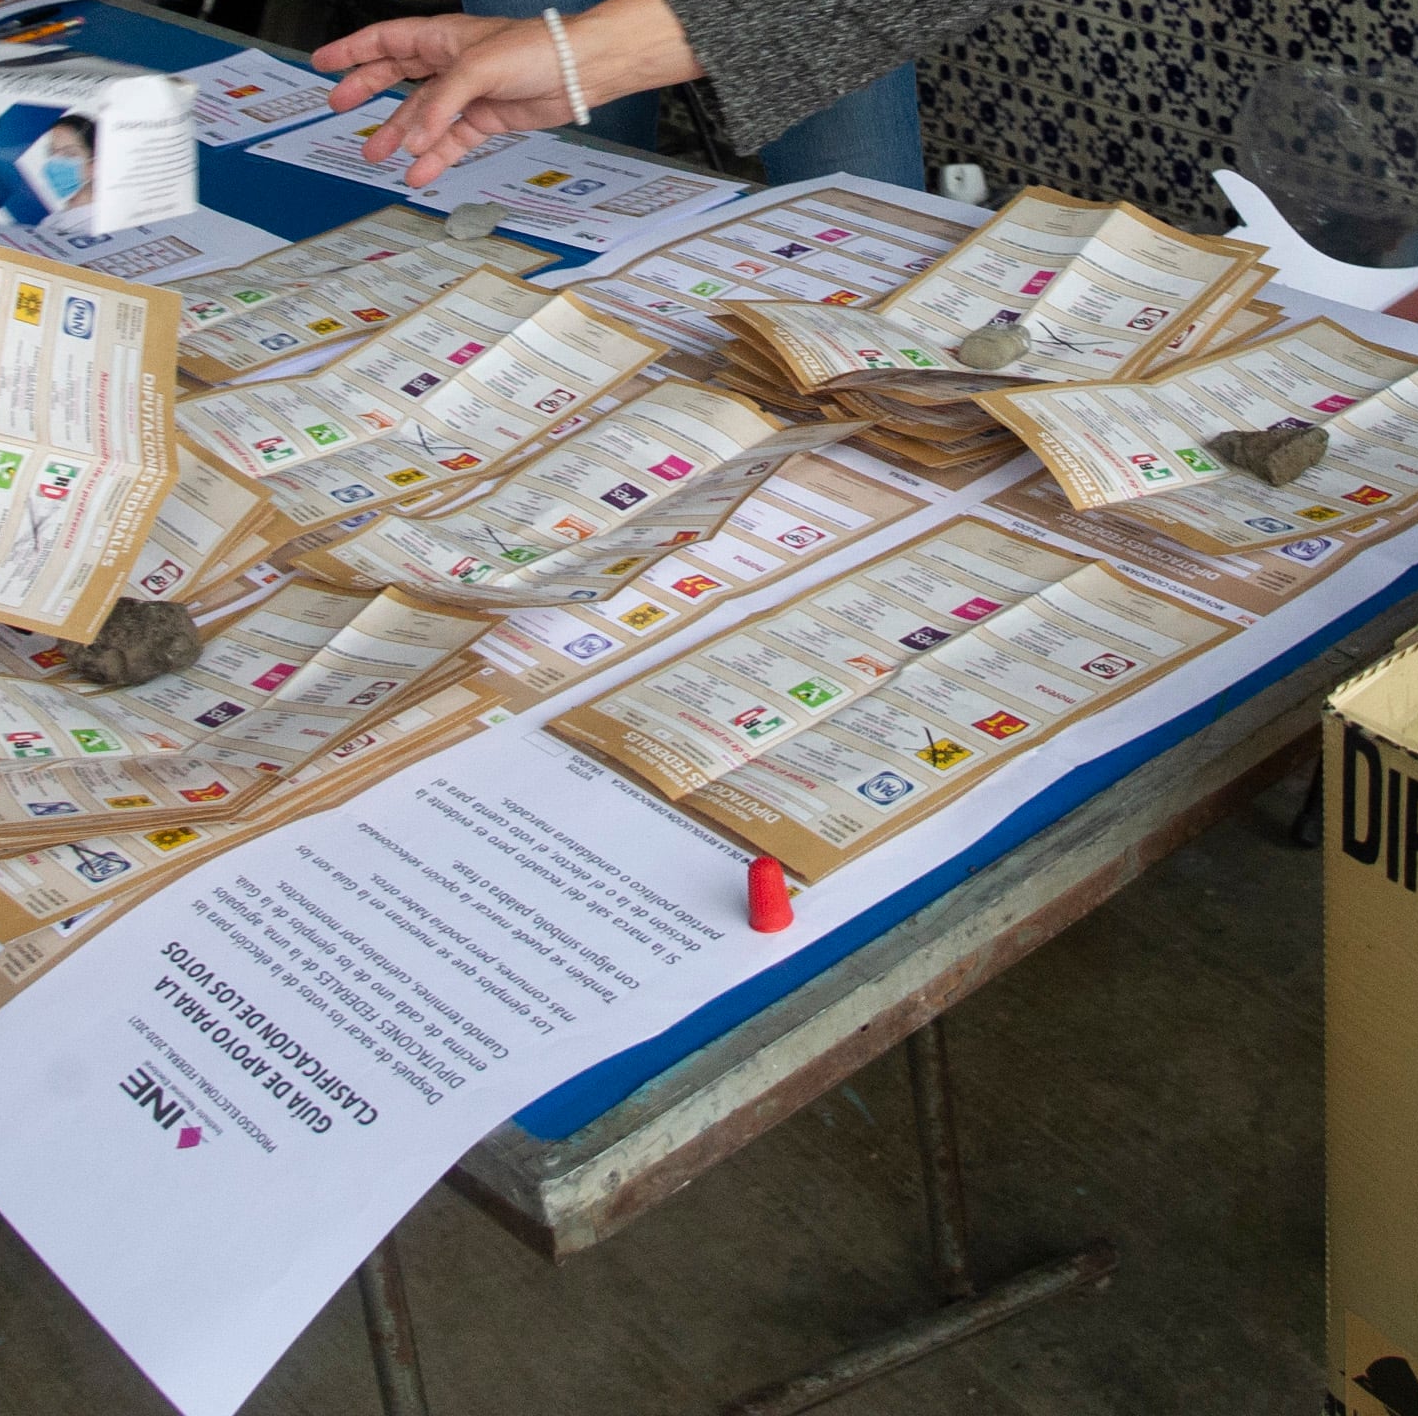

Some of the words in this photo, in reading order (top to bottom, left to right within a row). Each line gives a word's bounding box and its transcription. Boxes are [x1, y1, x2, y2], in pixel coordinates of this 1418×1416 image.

[140, 372, 157, 483] DIPUTACIONES
[101, 483, 149, 568] FEDERALES
[620, 730, 690, 772] FEDERALES
[414, 787, 429, 800] la
[429, 777, 448, 787] el
[445, 785, 476, 803] para
[871, 778, 899, 797] PAN
[686, 769, 780, 823] DIPUTACIOES
[426, 796, 474, 827] evidente
[470, 801, 510, 827] cuenta
[500, 796, 556, 834] marcados.
[471, 825, 489, 837] es
[507, 825, 535, 845] voto
[294, 844, 315, 859] los
[486, 835, 519, 855] pero
[530, 842, 549, 853] el
[552, 831, 621, 876] candidatura
[310, 856, 335, 872] son
[513, 853, 566, 888] recuadro
[549, 850, 592, 880] elector,
[234, 874, 262, 898] Guía.
[330, 870, 359, 891] Guía
[369, 872, 401, 895] otros.
[560, 885, 587, 901] del
[586, 879, 606, 889] el
[190, 898, 210, 916] las
[211, 886, 264, 926] agrúpalos
[259, 895, 274, 908] la
[275, 879, 342, 931] montoncitos.
[356, 888, 371, 901] la
[367, 897, 387, 910] en
[396, 894, 433, 920] haber
[615, 895, 631, 908] la
[628, 880, 680, 911] político
[205, 910, 236, 932] para
[271, 904, 289, 918] de
[585, 899, 613, 918] sale
[629, 904, 649, 917] de
[262, 924, 291, 949] urna,
[286, 916, 337, 955] ejemplos
[337, 928, 365, 945] por
[383, 909, 439, 948] muestran
[428, 916, 472, 944] podría
[610, 916, 652, 944] marca
[647, 916, 702, 951] decisión
[673, 909, 725, 941] partido
[228, 929, 273, 965] elección
[288, 947, 303, 961] la
[435, 947, 454, 959] se
[464, 942, 499, 964] pero
[650, 942, 667, 956] la
[661, 951, 682, 965] Si
[159, 940, 216, 988] VOTOS
[269, 962, 285, 977] la
[300, 957, 319, 971] de
[334, 954, 355, 972] los
[352, 968, 372, 982] de
[356, 942, 412, 984] cuéntalos
[450, 958, 477, 976] que
[152, 974, 182, 1000] LA
[280, 972, 300, 987] de
[369, 981, 396, 1001] uno
[494, 961, 550, 1003] comunes,
[206, 980, 246, 1012] LOS
[295, 984, 329, 1012] votos
[312, 970, 381, 1022] FEDERALES
[410, 980, 465, 1025] termines,
[474, 975, 531, 1016] ejemplos
[171, 991, 220, 1033] PARA
[233, 1003, 267, 1030] DE
[325, 1008, 348, 1028] los
[394, 999, 425, 1023] cada
[546, 1001, 577, 1022] más
[127, 1015, 168, 1051] 2020-2021
[342, 1023, 378, 1049] sacar
[423, 1022, 443, 1037] de
[528, 1015, 555, 1035] Los
[209, 1026, 272, 1078] APOYO
[460, 1021, 509, 1059] Cuando
[163, 1046, 199, 1080] FEDERAL
[373, 1046, 393, 1063] de
[374, 1018, 466, 1089] DIPUTACIONES
[441, 1036, 488, 1072] encima
[255, 1021, 379, 1126] CLASIFICACIÓN
[260, 1070, 294, 1100] DE
[390, 1060, 444, 1106] Después
[117, 1066, 186, 1131] INE
[195, 1075, 241, 1120] ELECTORAL
[285, 1090, 333, 1134] GUÍA
[235, 1115, 277, 1154] PROCESO
